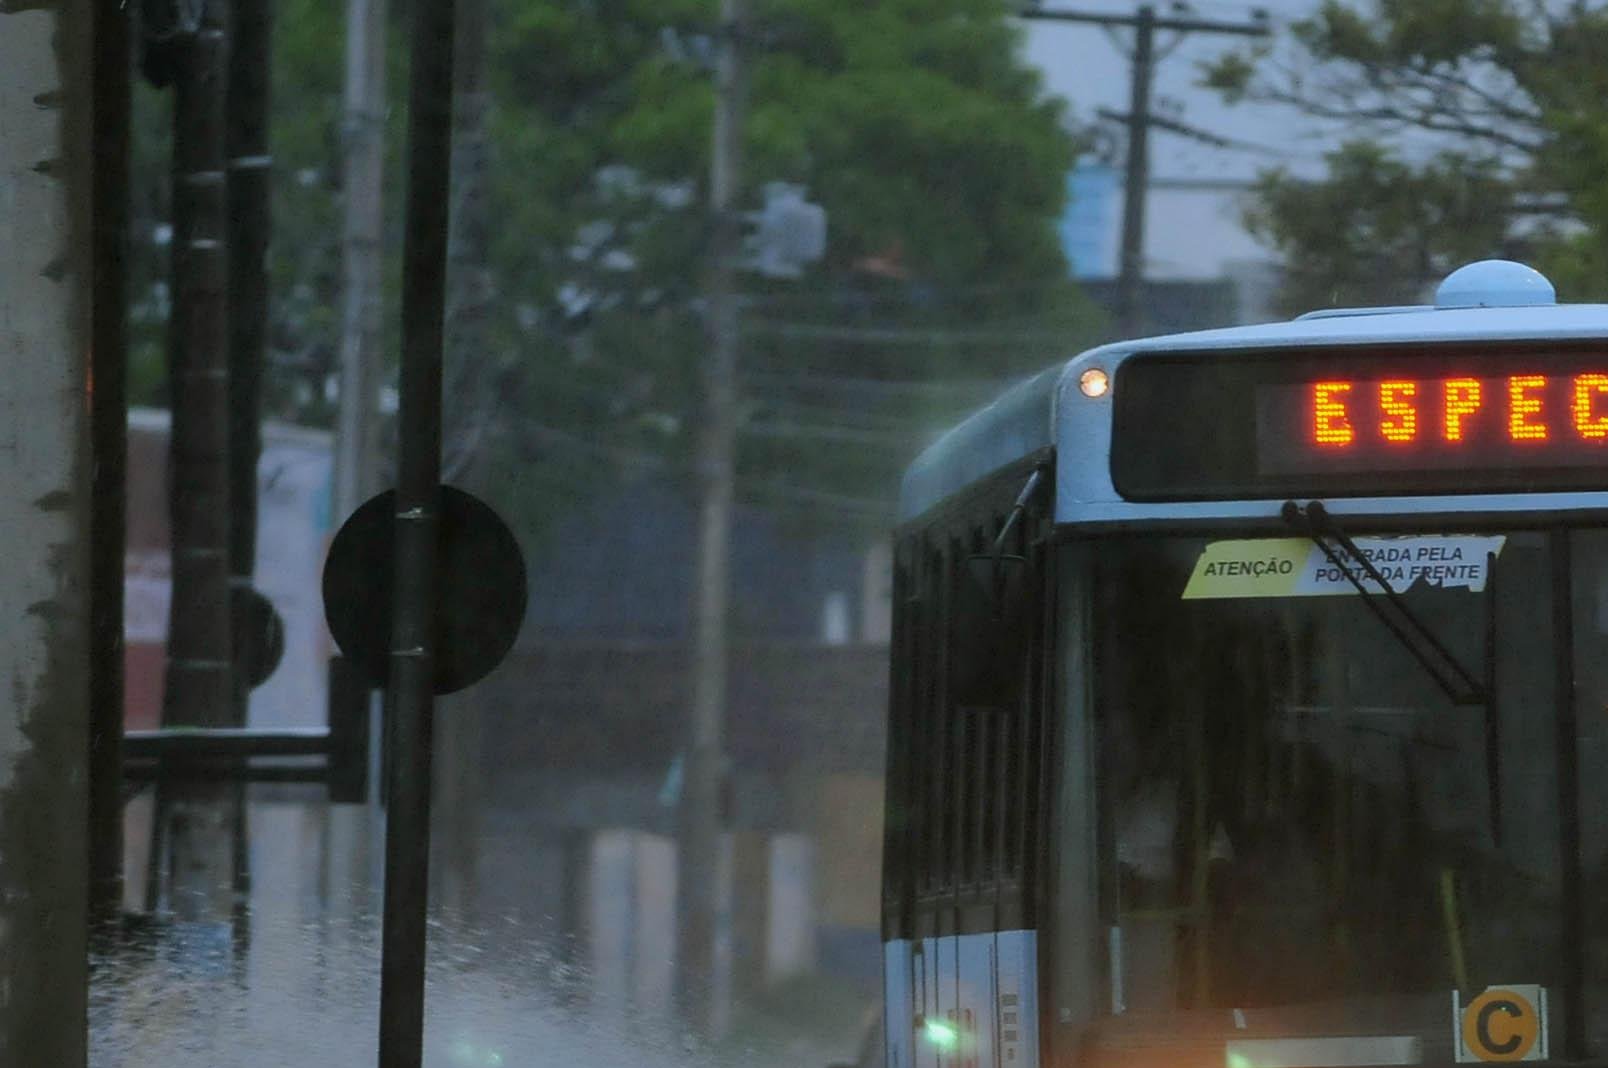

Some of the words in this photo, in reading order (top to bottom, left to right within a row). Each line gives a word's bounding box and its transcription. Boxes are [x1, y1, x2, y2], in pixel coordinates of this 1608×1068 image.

[1326, 547, 1412, 565] ENRADA
[1416, 546, 1463, 562] PELA
[1204, 558, 1293, 577] ATENÇÃO
[1380, 566, 1404, 580] DA
[1408, 564, 1480, 580] FRENTE
[1476, 999, 1522, 1055] C
